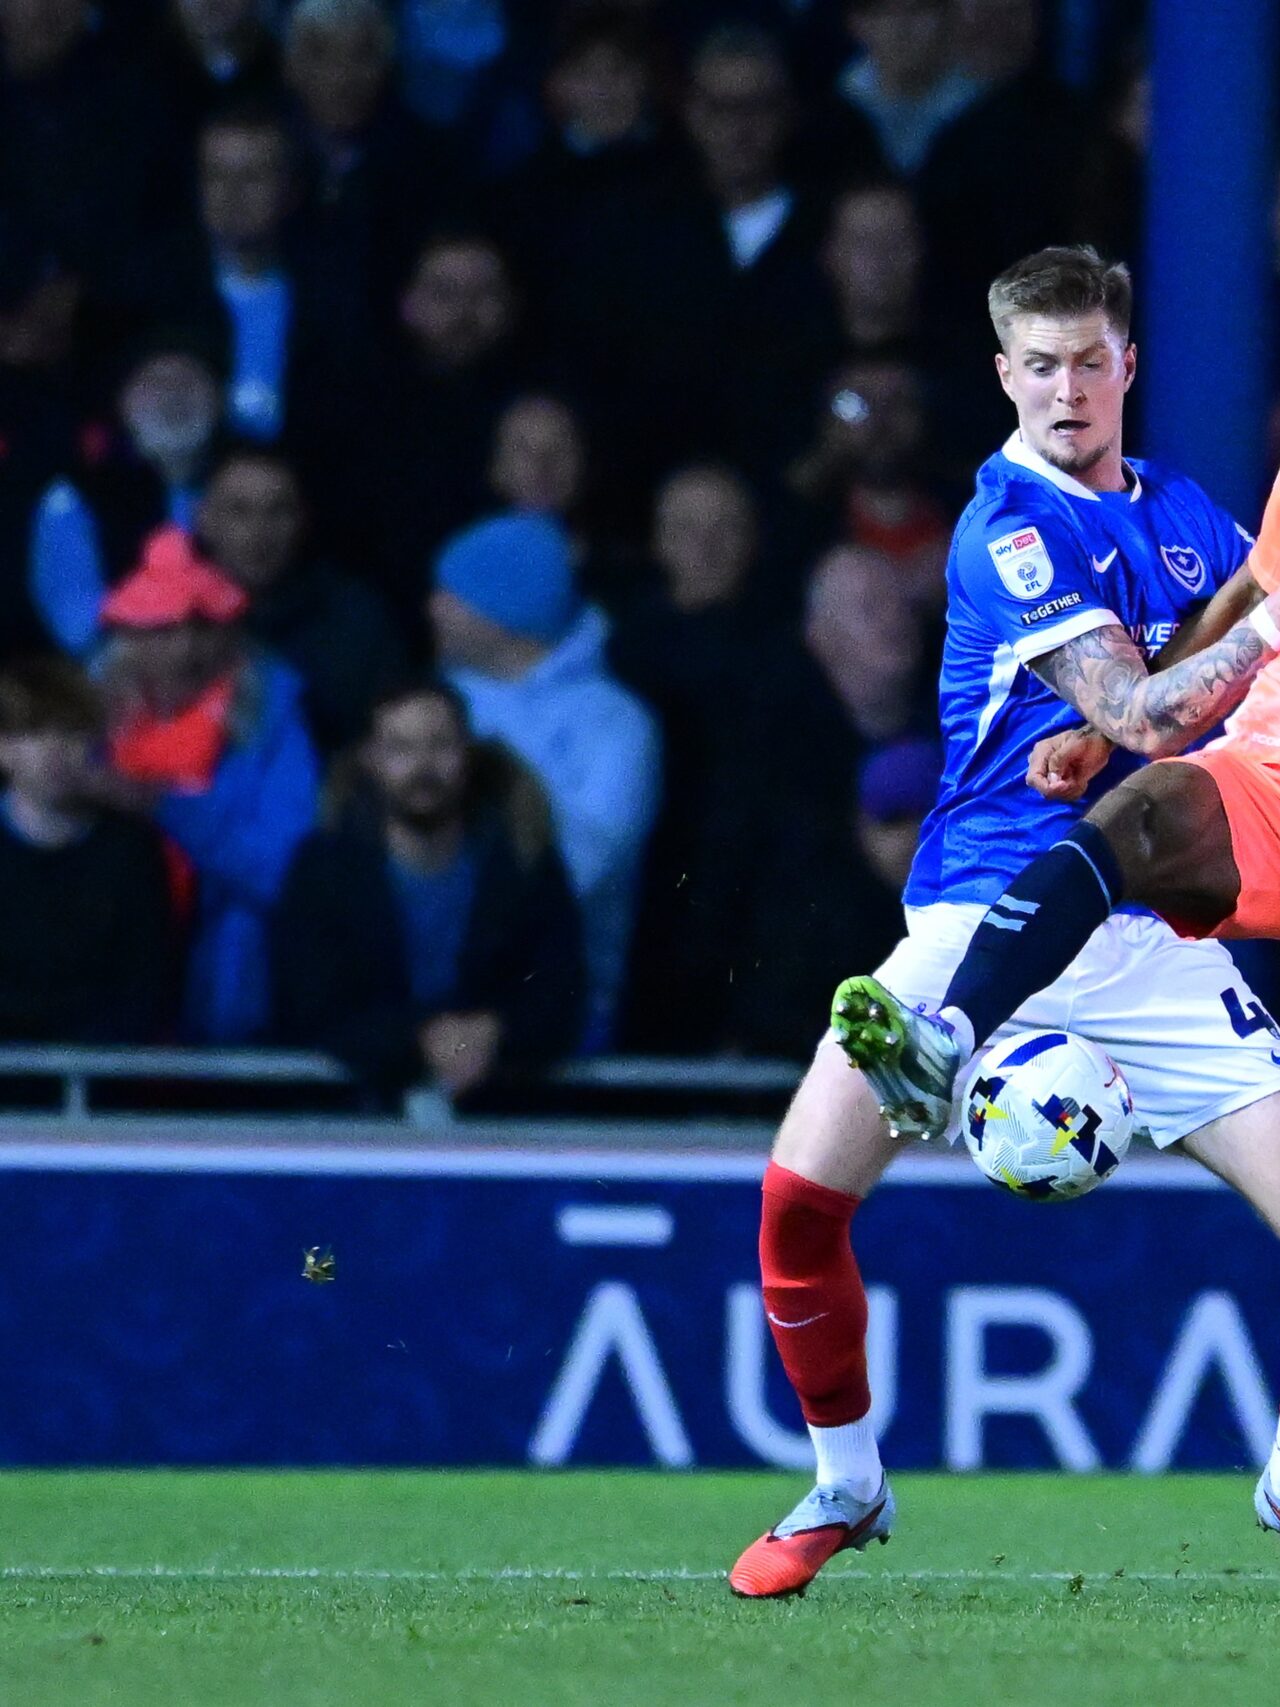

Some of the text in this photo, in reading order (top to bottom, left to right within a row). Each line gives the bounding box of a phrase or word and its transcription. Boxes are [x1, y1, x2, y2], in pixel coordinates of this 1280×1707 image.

[996, 533, 1036, 556] sky bet
[1025, 580, 1042, 592] EFL
[1022, 592, 1082, 625] TOGETHER
